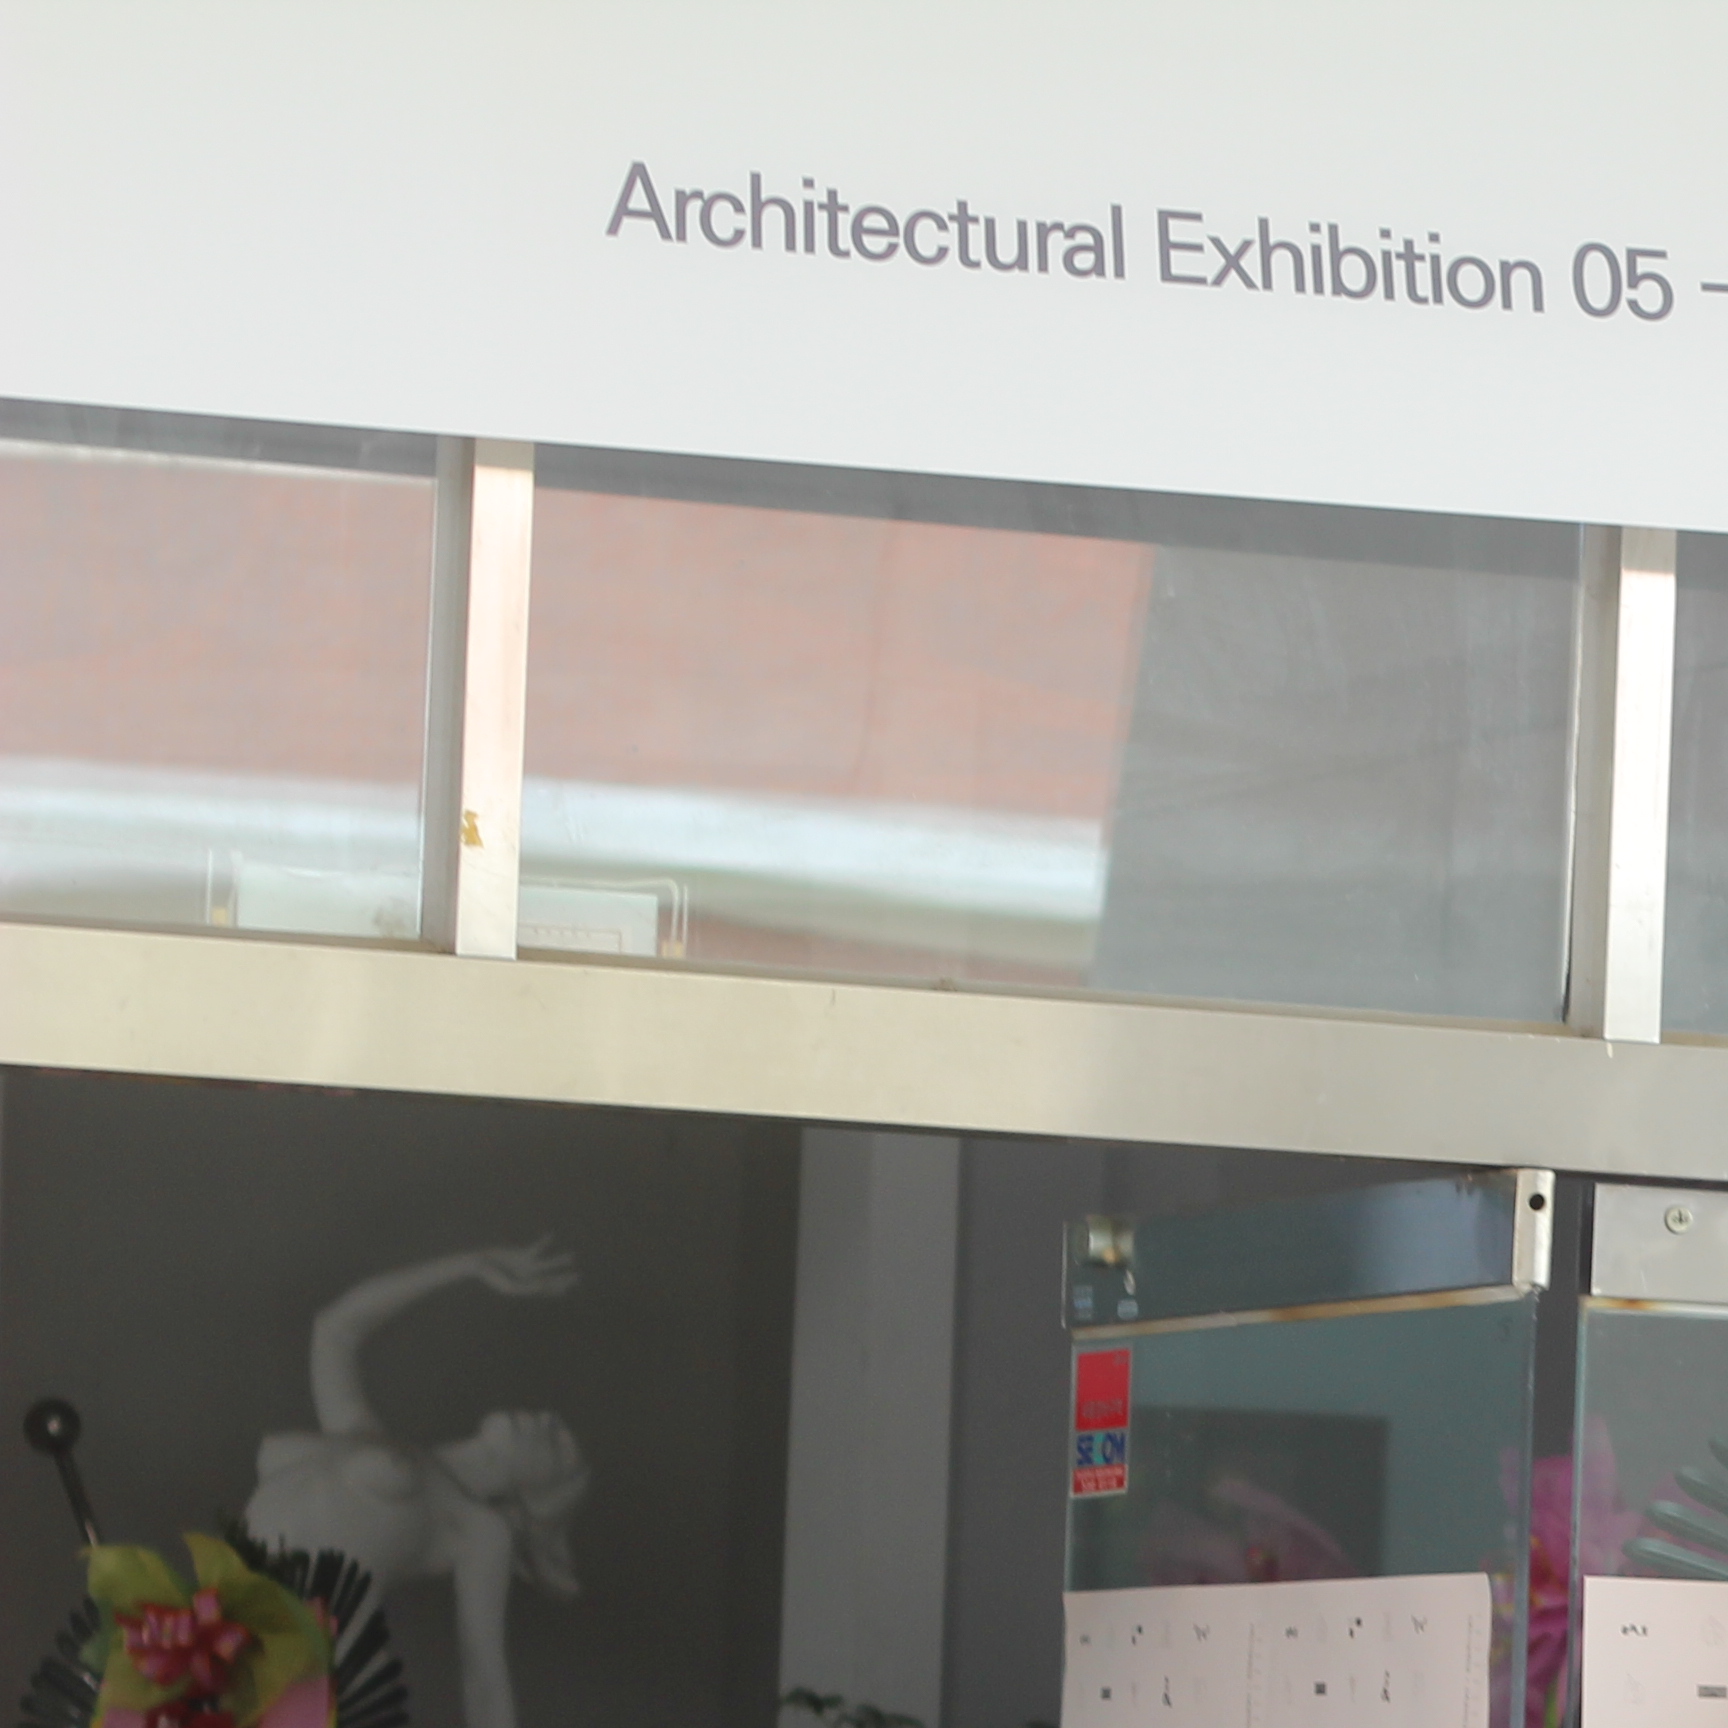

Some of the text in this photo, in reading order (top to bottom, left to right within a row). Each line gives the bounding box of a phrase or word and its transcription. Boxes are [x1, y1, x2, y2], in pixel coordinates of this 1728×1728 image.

[605, 161, 1126, 281] Architectural
[1156, 208, 1545, 315] Exhibition
[1572, 242, 1675, 322] 05
